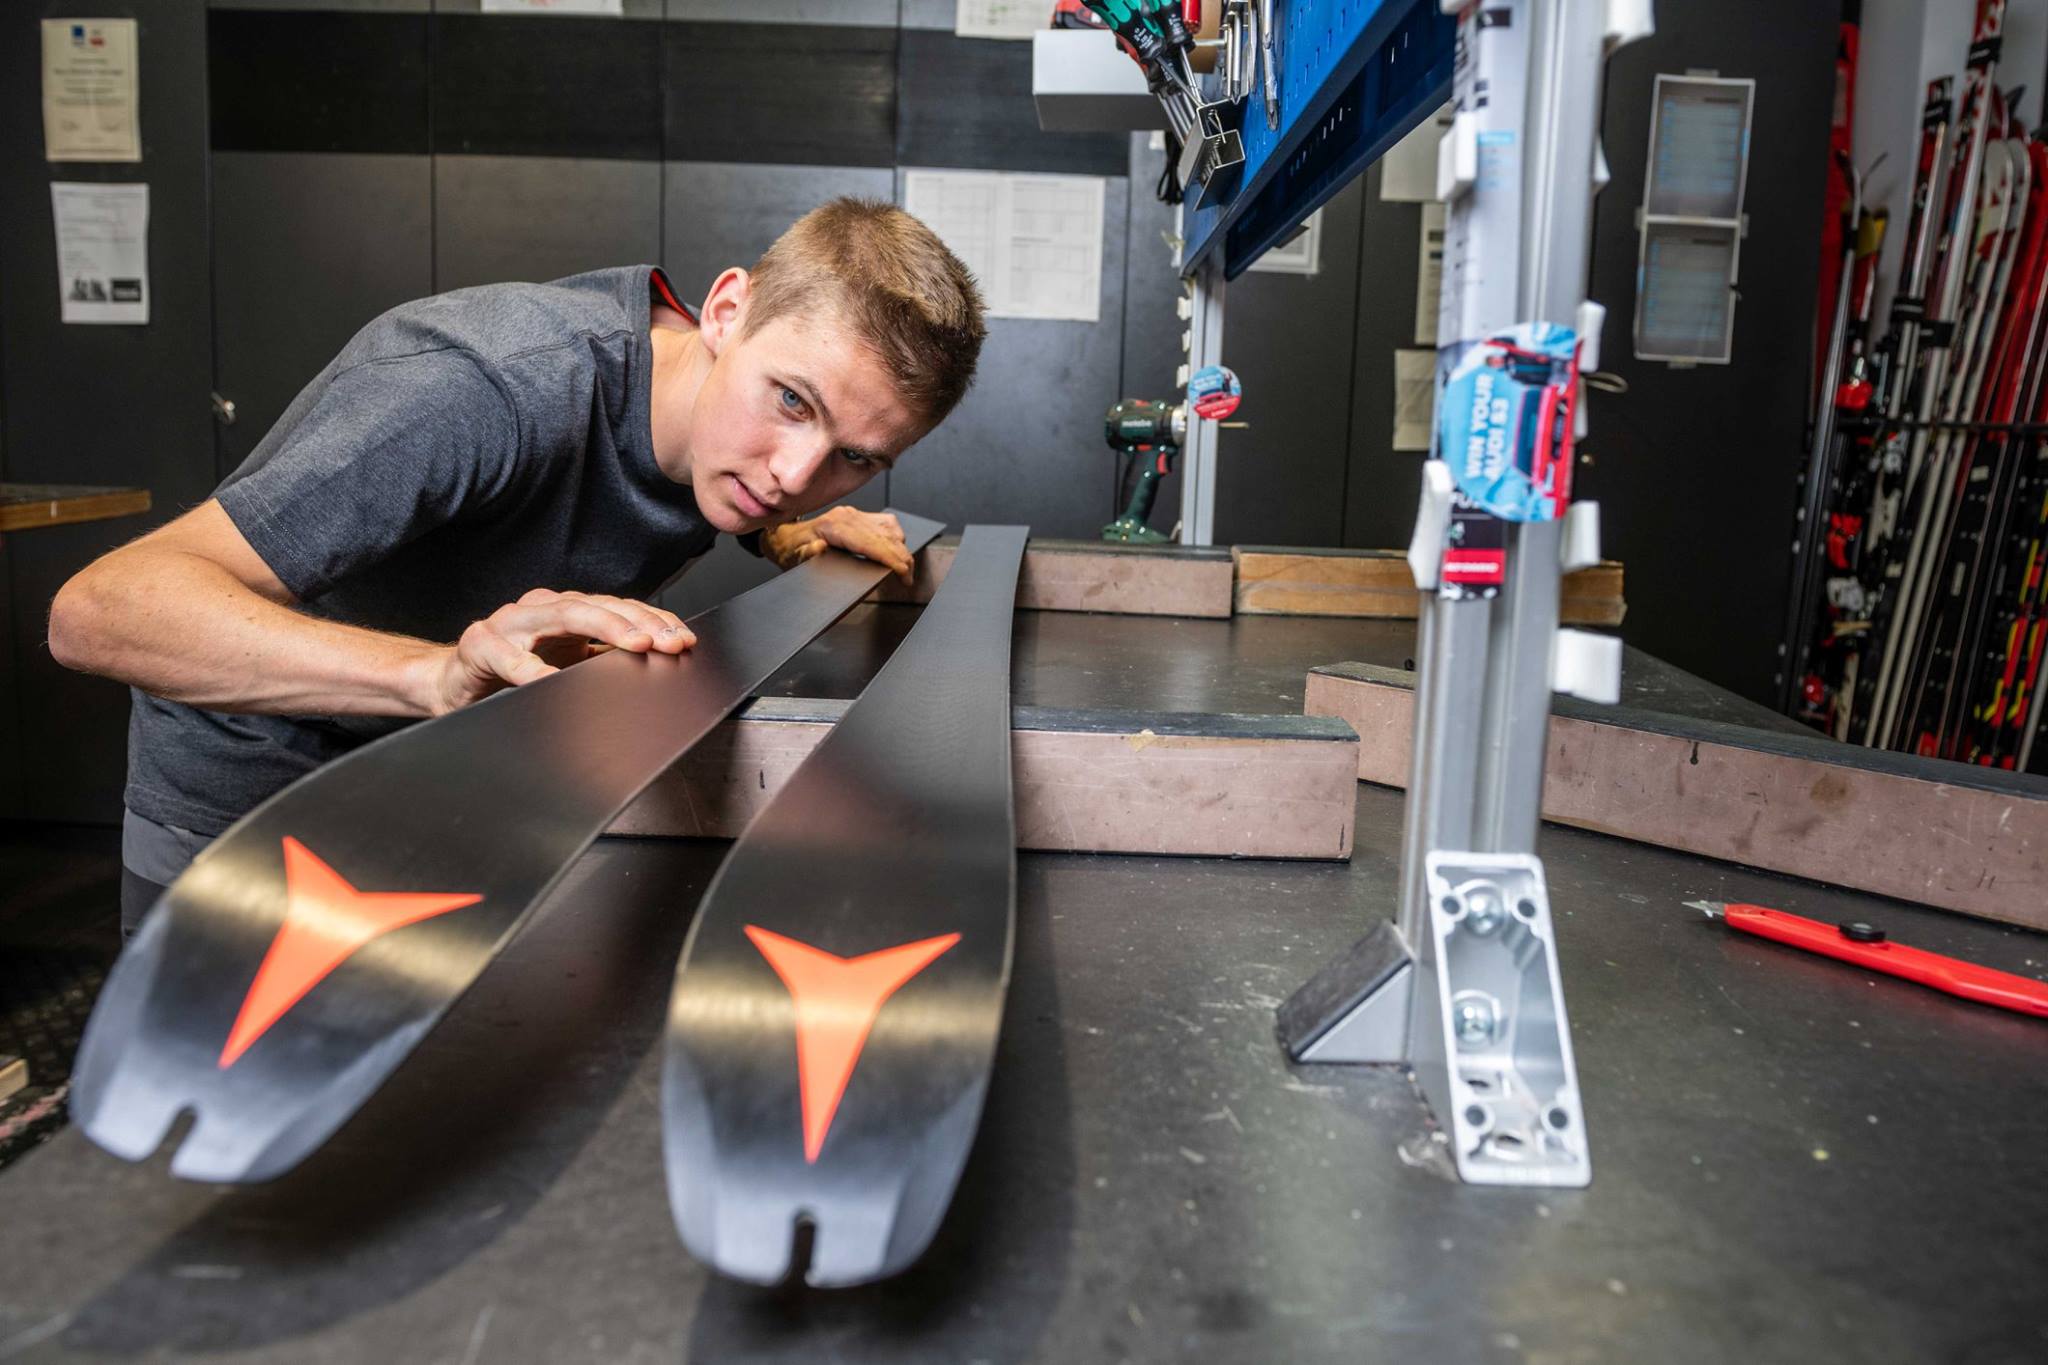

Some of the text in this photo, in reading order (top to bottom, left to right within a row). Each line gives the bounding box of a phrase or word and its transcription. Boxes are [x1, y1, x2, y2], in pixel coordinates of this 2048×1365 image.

[1472, 374, 1494, 432] YOUR
[1465, 435, 1485, 479] WIN
[1485, 428, 1505, 481] AUDI
